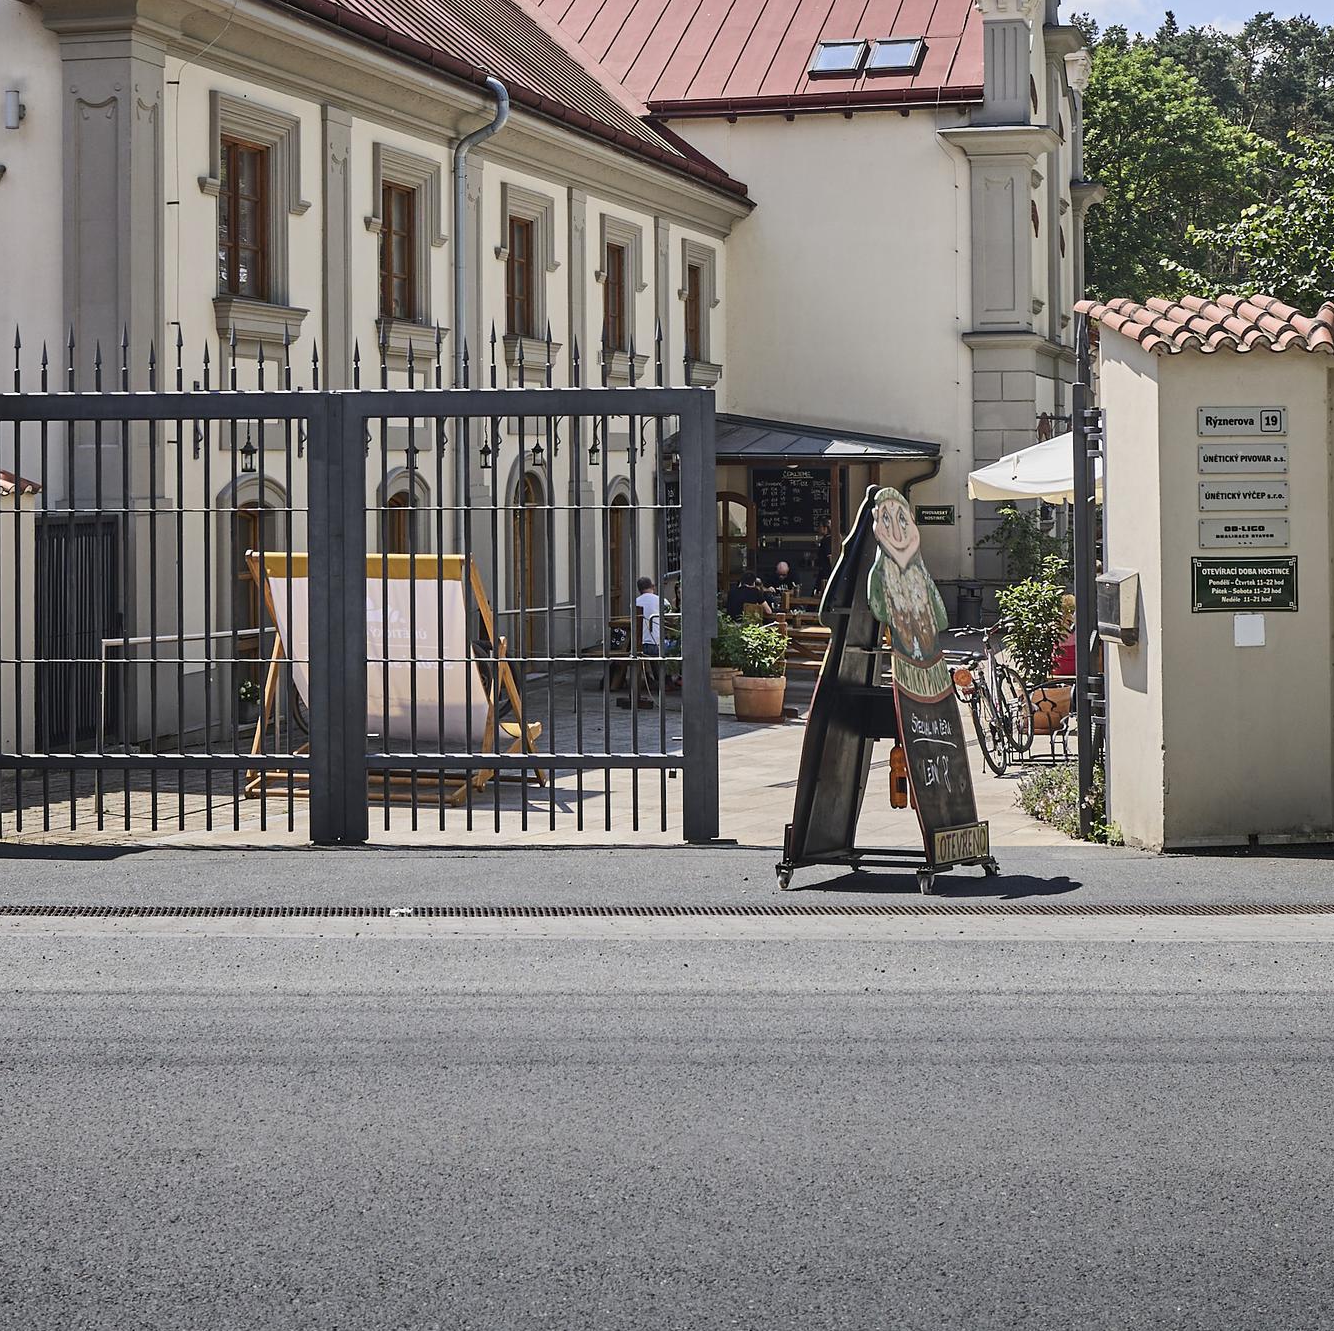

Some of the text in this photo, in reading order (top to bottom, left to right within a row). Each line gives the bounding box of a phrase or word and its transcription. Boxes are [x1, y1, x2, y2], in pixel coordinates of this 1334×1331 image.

[1205, 415, 1278, 428] Rýznerova 19
[1203, 453, 1239, 462] ÚNĚTICKÝ
[1204, 491, 1241, 500] ÚNĚTICKÝ
[1242, 491, 1266, 499] VÝČEP
[1202, 567, 1237, 575] OTEVÍRACÍ
